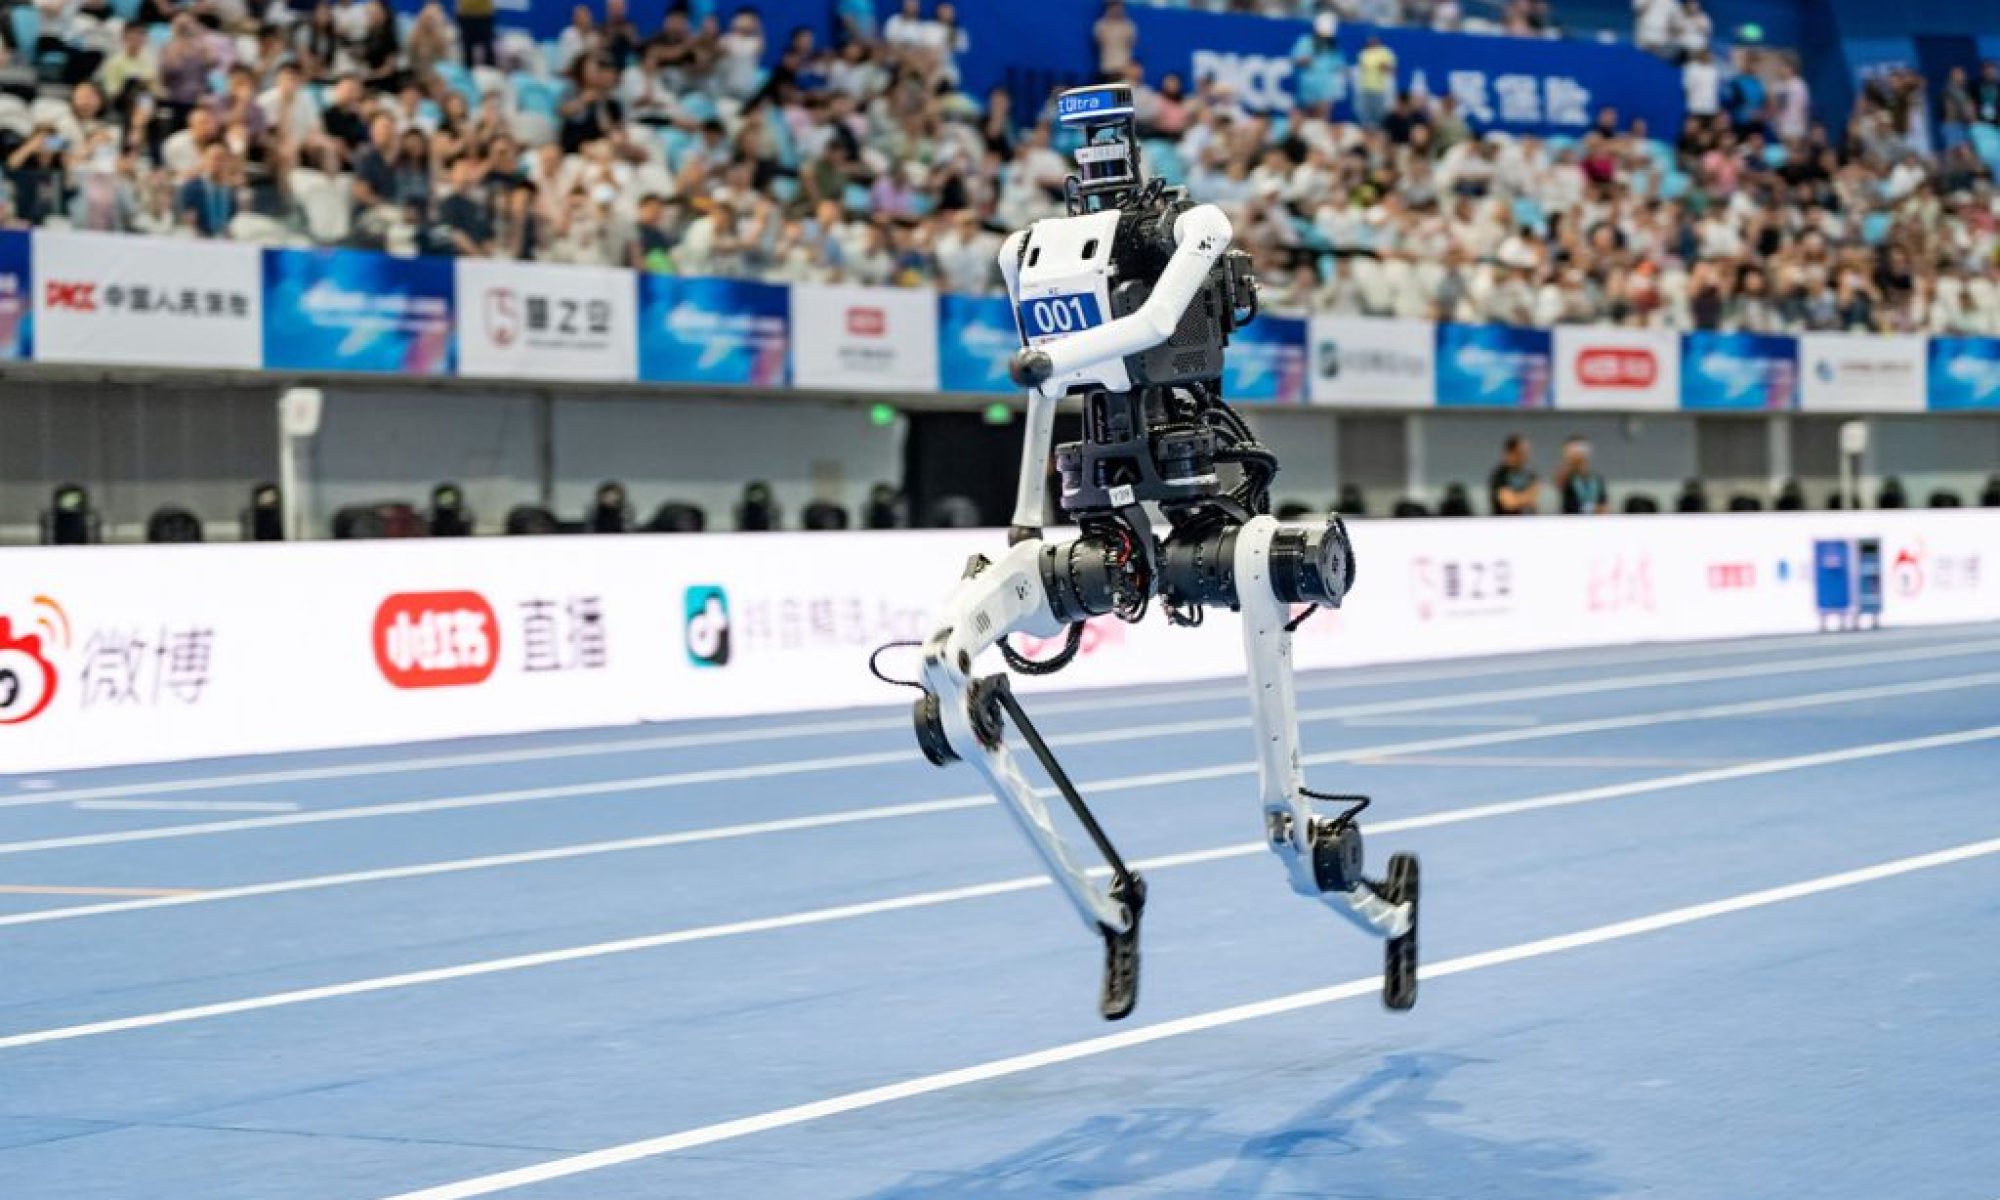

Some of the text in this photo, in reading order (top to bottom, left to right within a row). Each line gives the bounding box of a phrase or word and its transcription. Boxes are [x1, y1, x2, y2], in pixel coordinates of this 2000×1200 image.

[1066, 96, 1101, 112] Ultra
[46, 280, 96, 314] PICC
[1034, 296, 1088, 333] 001
[385, 608, 491, 672] 小红书
[517, 596, 606, 673] 直播
[80, 626, 214, 709] 微博
